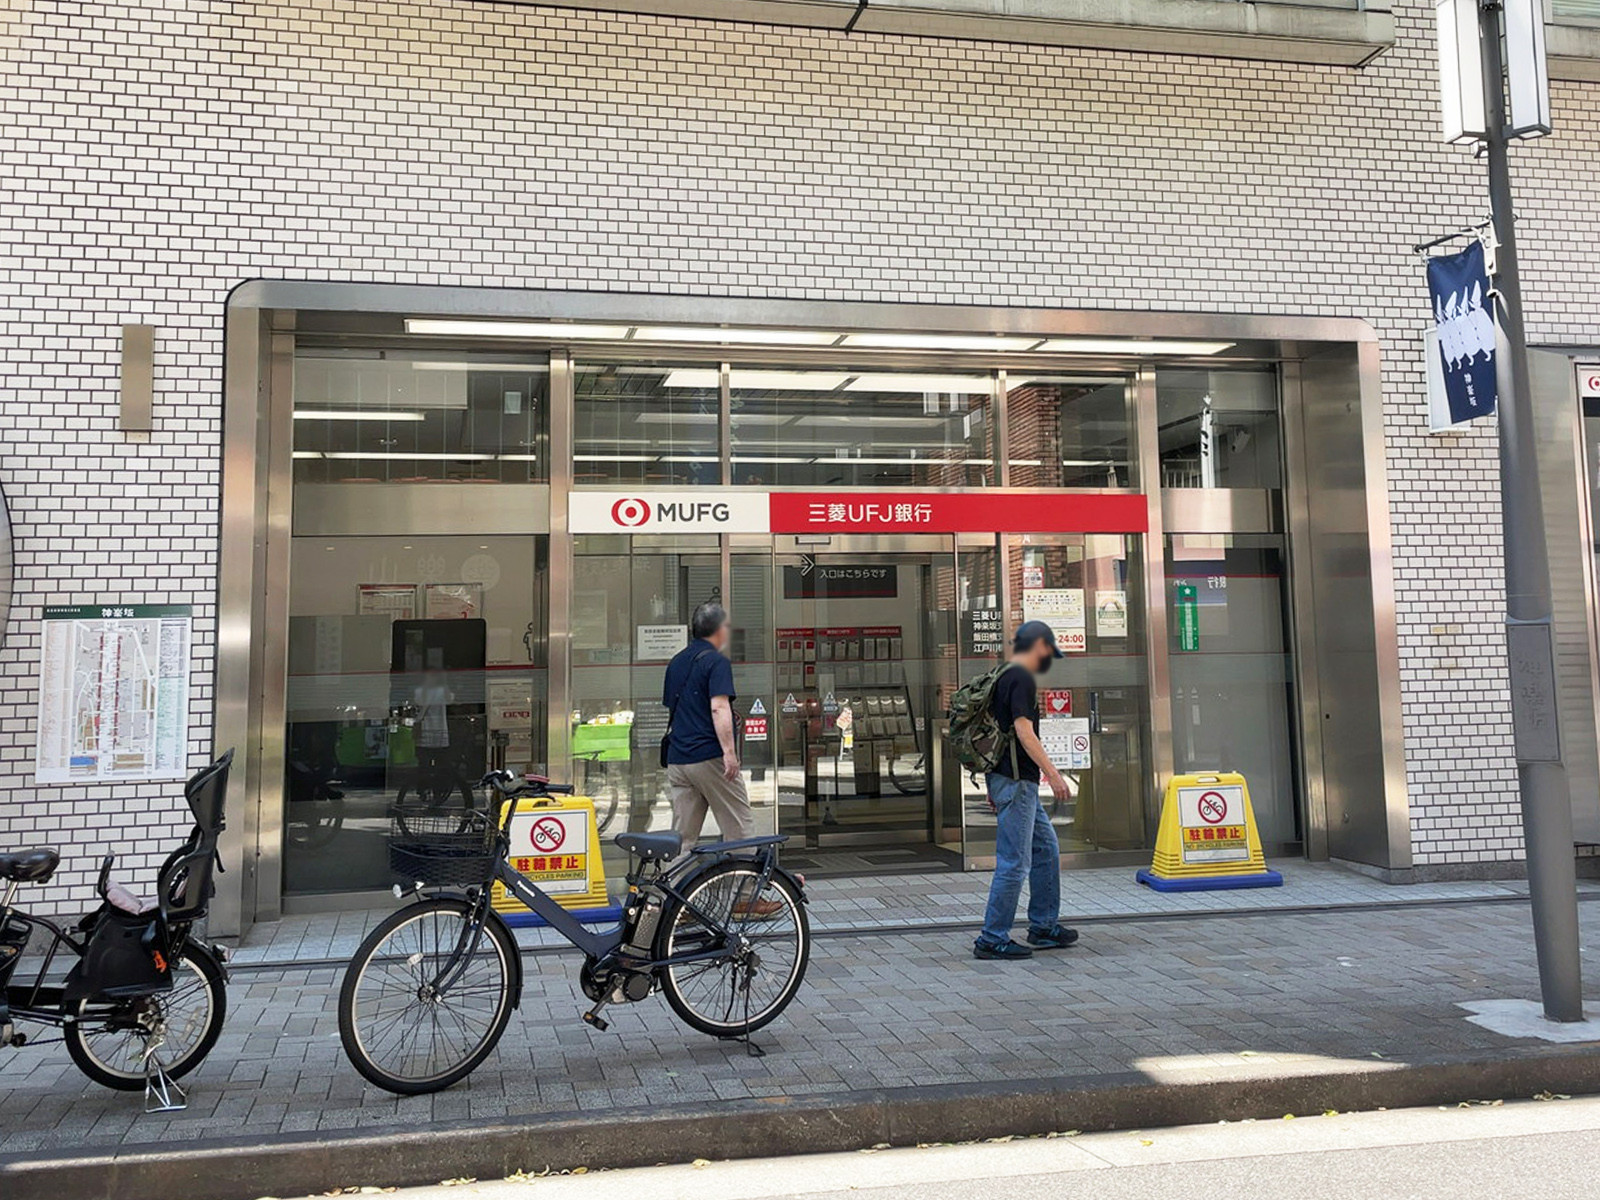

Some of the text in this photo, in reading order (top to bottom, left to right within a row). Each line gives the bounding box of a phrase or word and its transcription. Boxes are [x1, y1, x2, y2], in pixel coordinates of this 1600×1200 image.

[657, 503, 730, 522] MUFG
[808, 503, 933, 522] 三菱UFJ銀行
[820, 569, 887, 579] 入口はこちらです
[101, 607, 134, 617] 神楽坂
[1189, 827, 1240, 841] 駐輪禁止
[517, 855, 579, 872] 駐輪禁止
